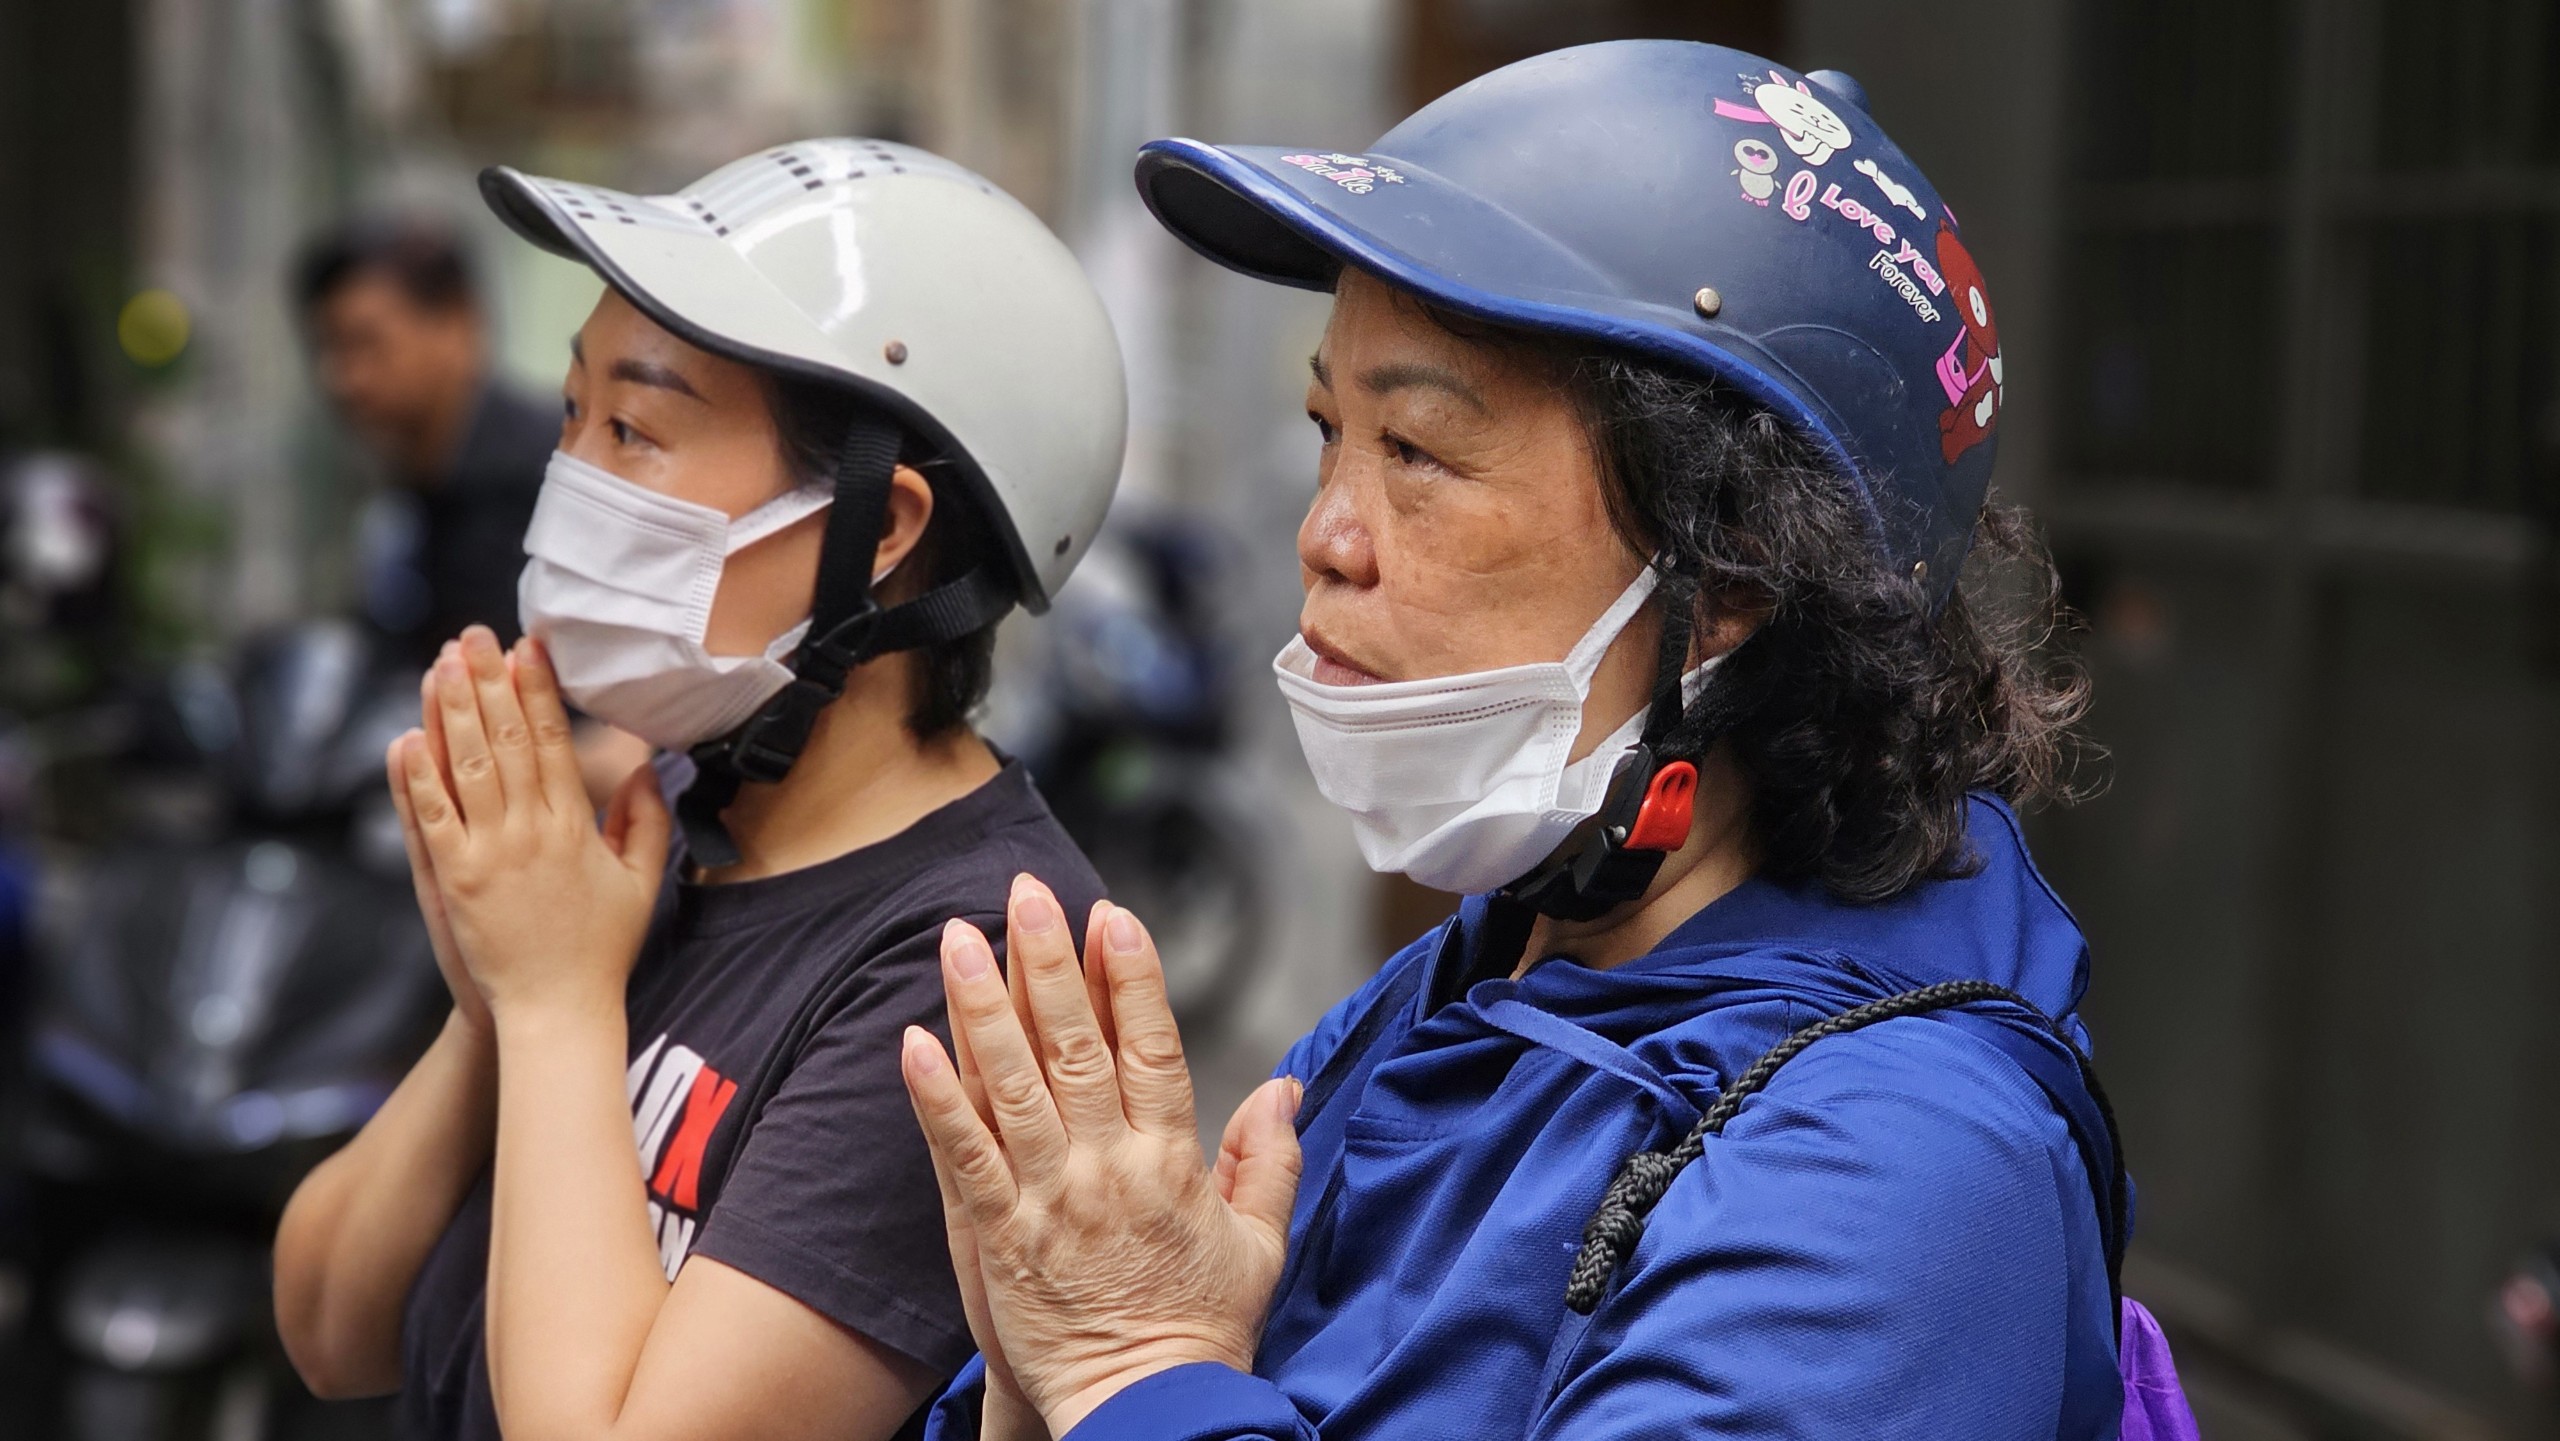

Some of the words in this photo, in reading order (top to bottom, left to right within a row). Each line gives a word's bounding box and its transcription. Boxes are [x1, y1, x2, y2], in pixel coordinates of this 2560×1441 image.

[1819, 183, 1897, 244] Love
[1892, 238, 1946, 297] you
[1869, 249, 1941, 323] Forever
